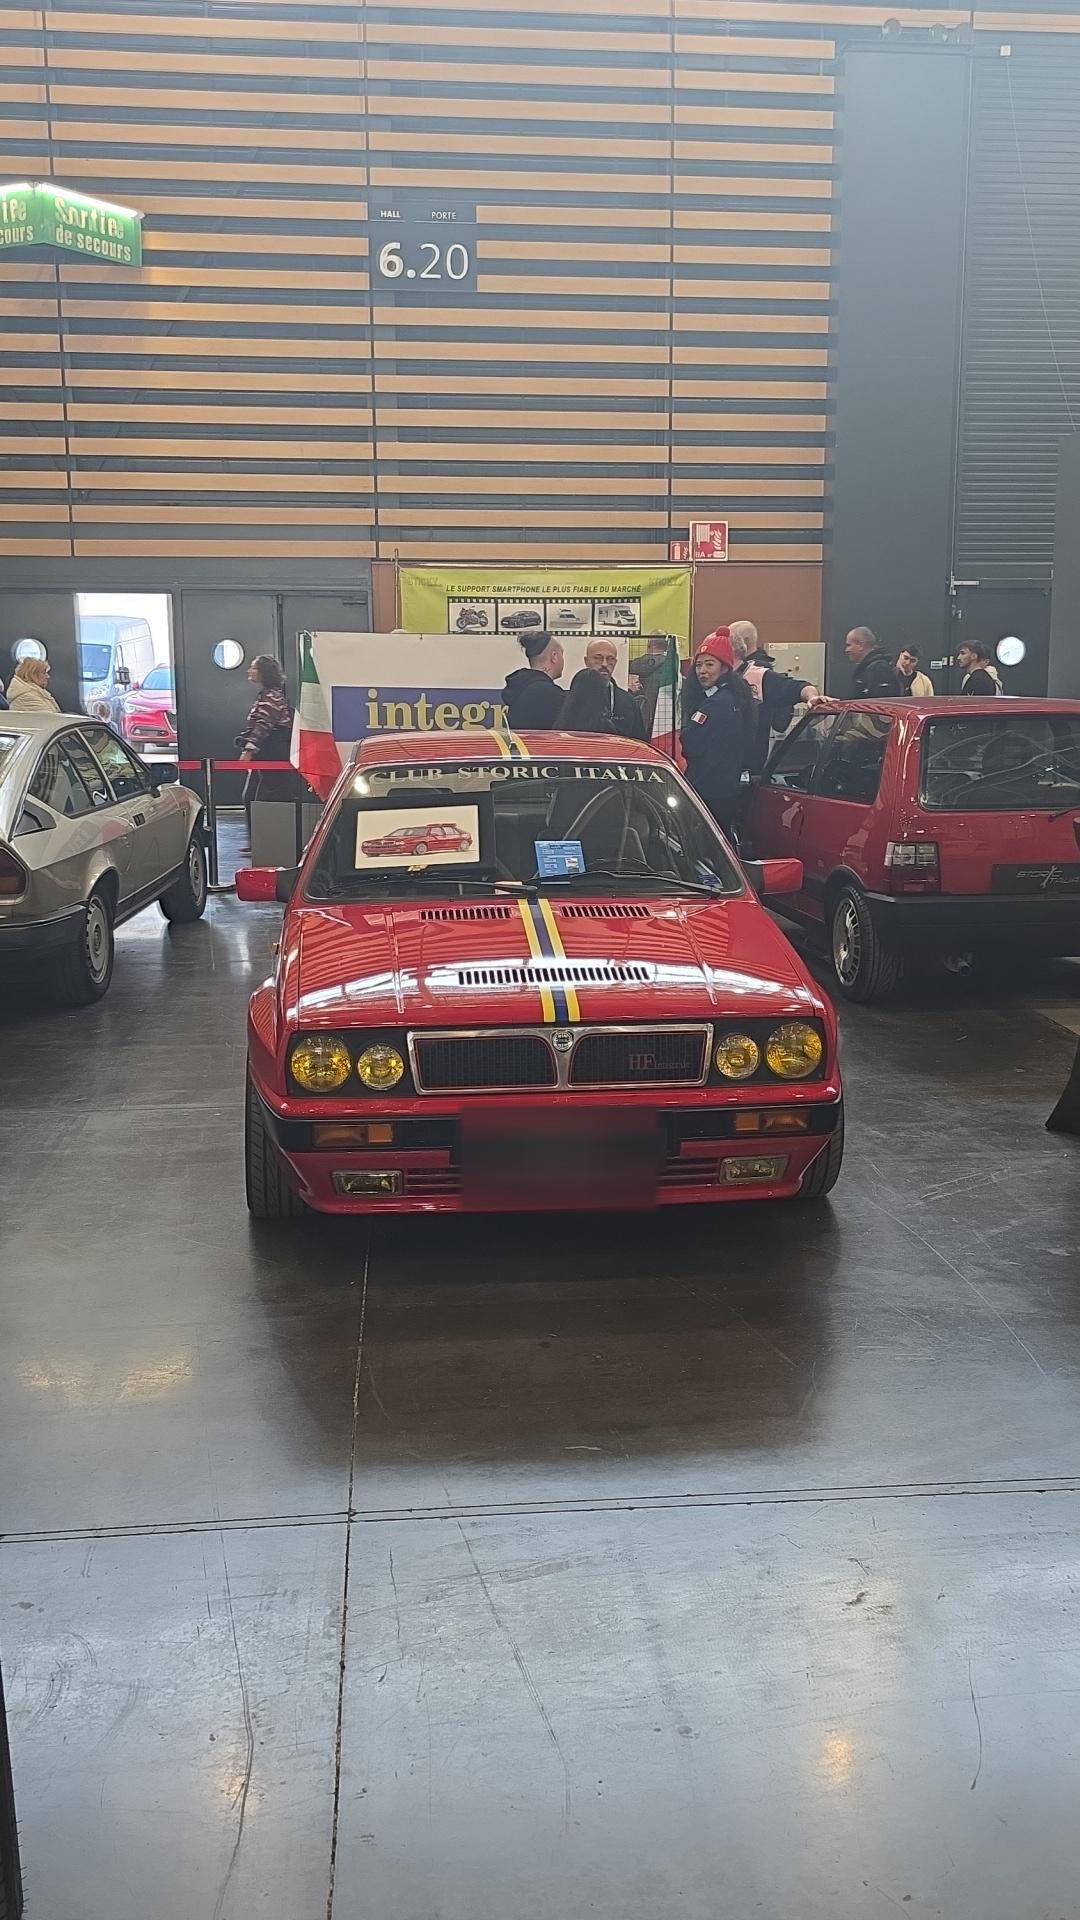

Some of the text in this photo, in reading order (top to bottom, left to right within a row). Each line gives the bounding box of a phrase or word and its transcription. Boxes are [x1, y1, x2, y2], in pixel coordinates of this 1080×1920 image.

[54, 196, 125, 240] Sortie
[380, 210, 400, 218] HALL
[431, 212, 457, 220] PORTE
[0, 224, 34, 245] cours
[55, 224, 132, 261] de secours
[379, 242, 469, 280] 6.20
[491, 585, 541, 593] SMARTPHONE
[542, 585, 551, 593] LE
[552, 585, 571, 593] PLUS
[572, 585, 598, 593] FIABLE
[600, 585, 610, 593] DU
[611, 584, 641, 593] MARCHÉ
[369, 765, 665, 784] CLUB STORIC ITALIA
